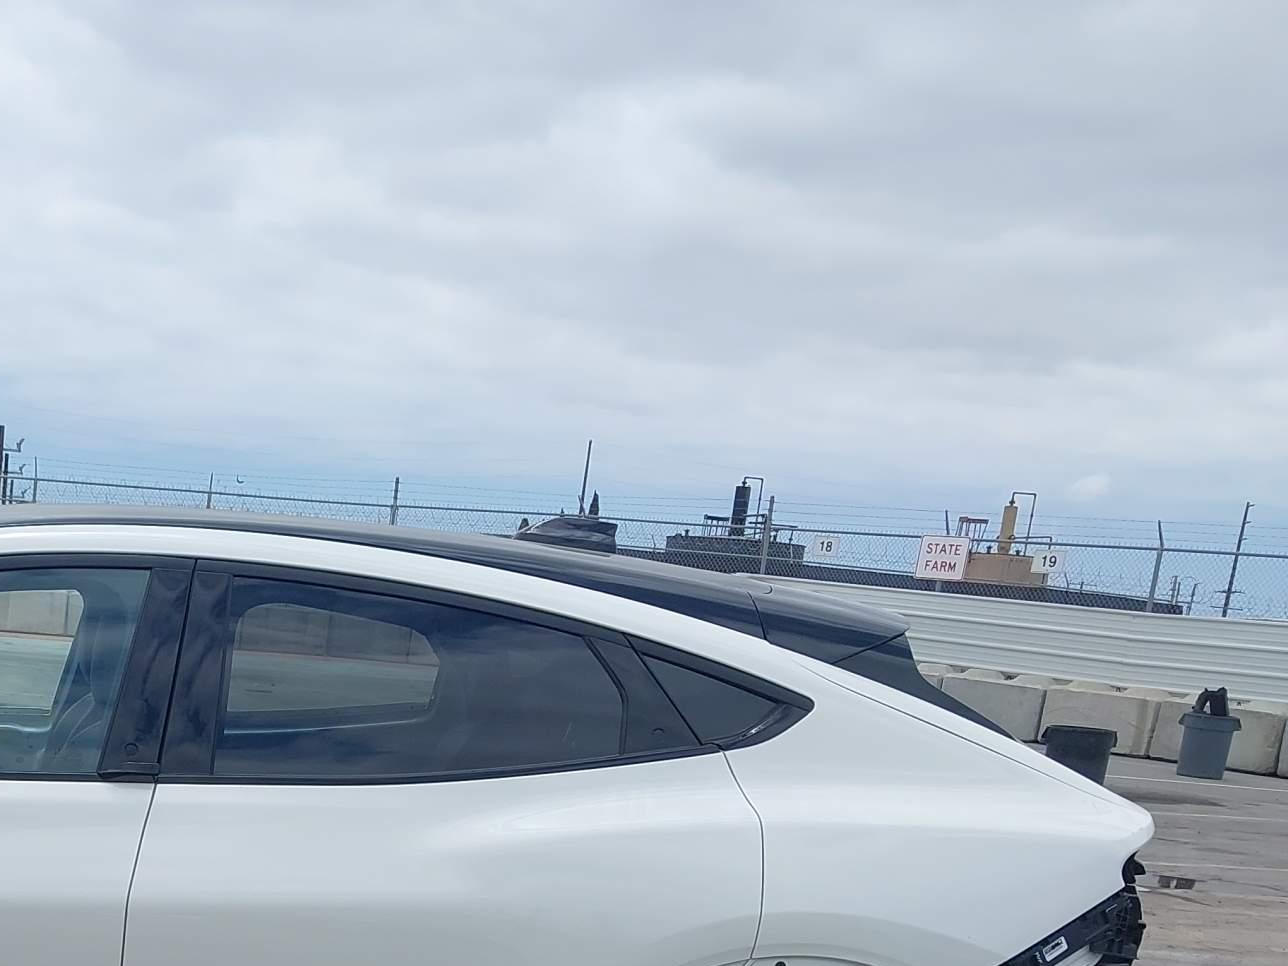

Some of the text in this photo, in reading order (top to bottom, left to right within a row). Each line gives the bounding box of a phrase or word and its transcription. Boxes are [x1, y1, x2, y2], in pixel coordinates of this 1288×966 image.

[820, 540, 833, 553] 18
[926, 542, 962, 556] STATE
[924, 560, 957, 573] FARM
[1041, 555, 1057, 568] 19
